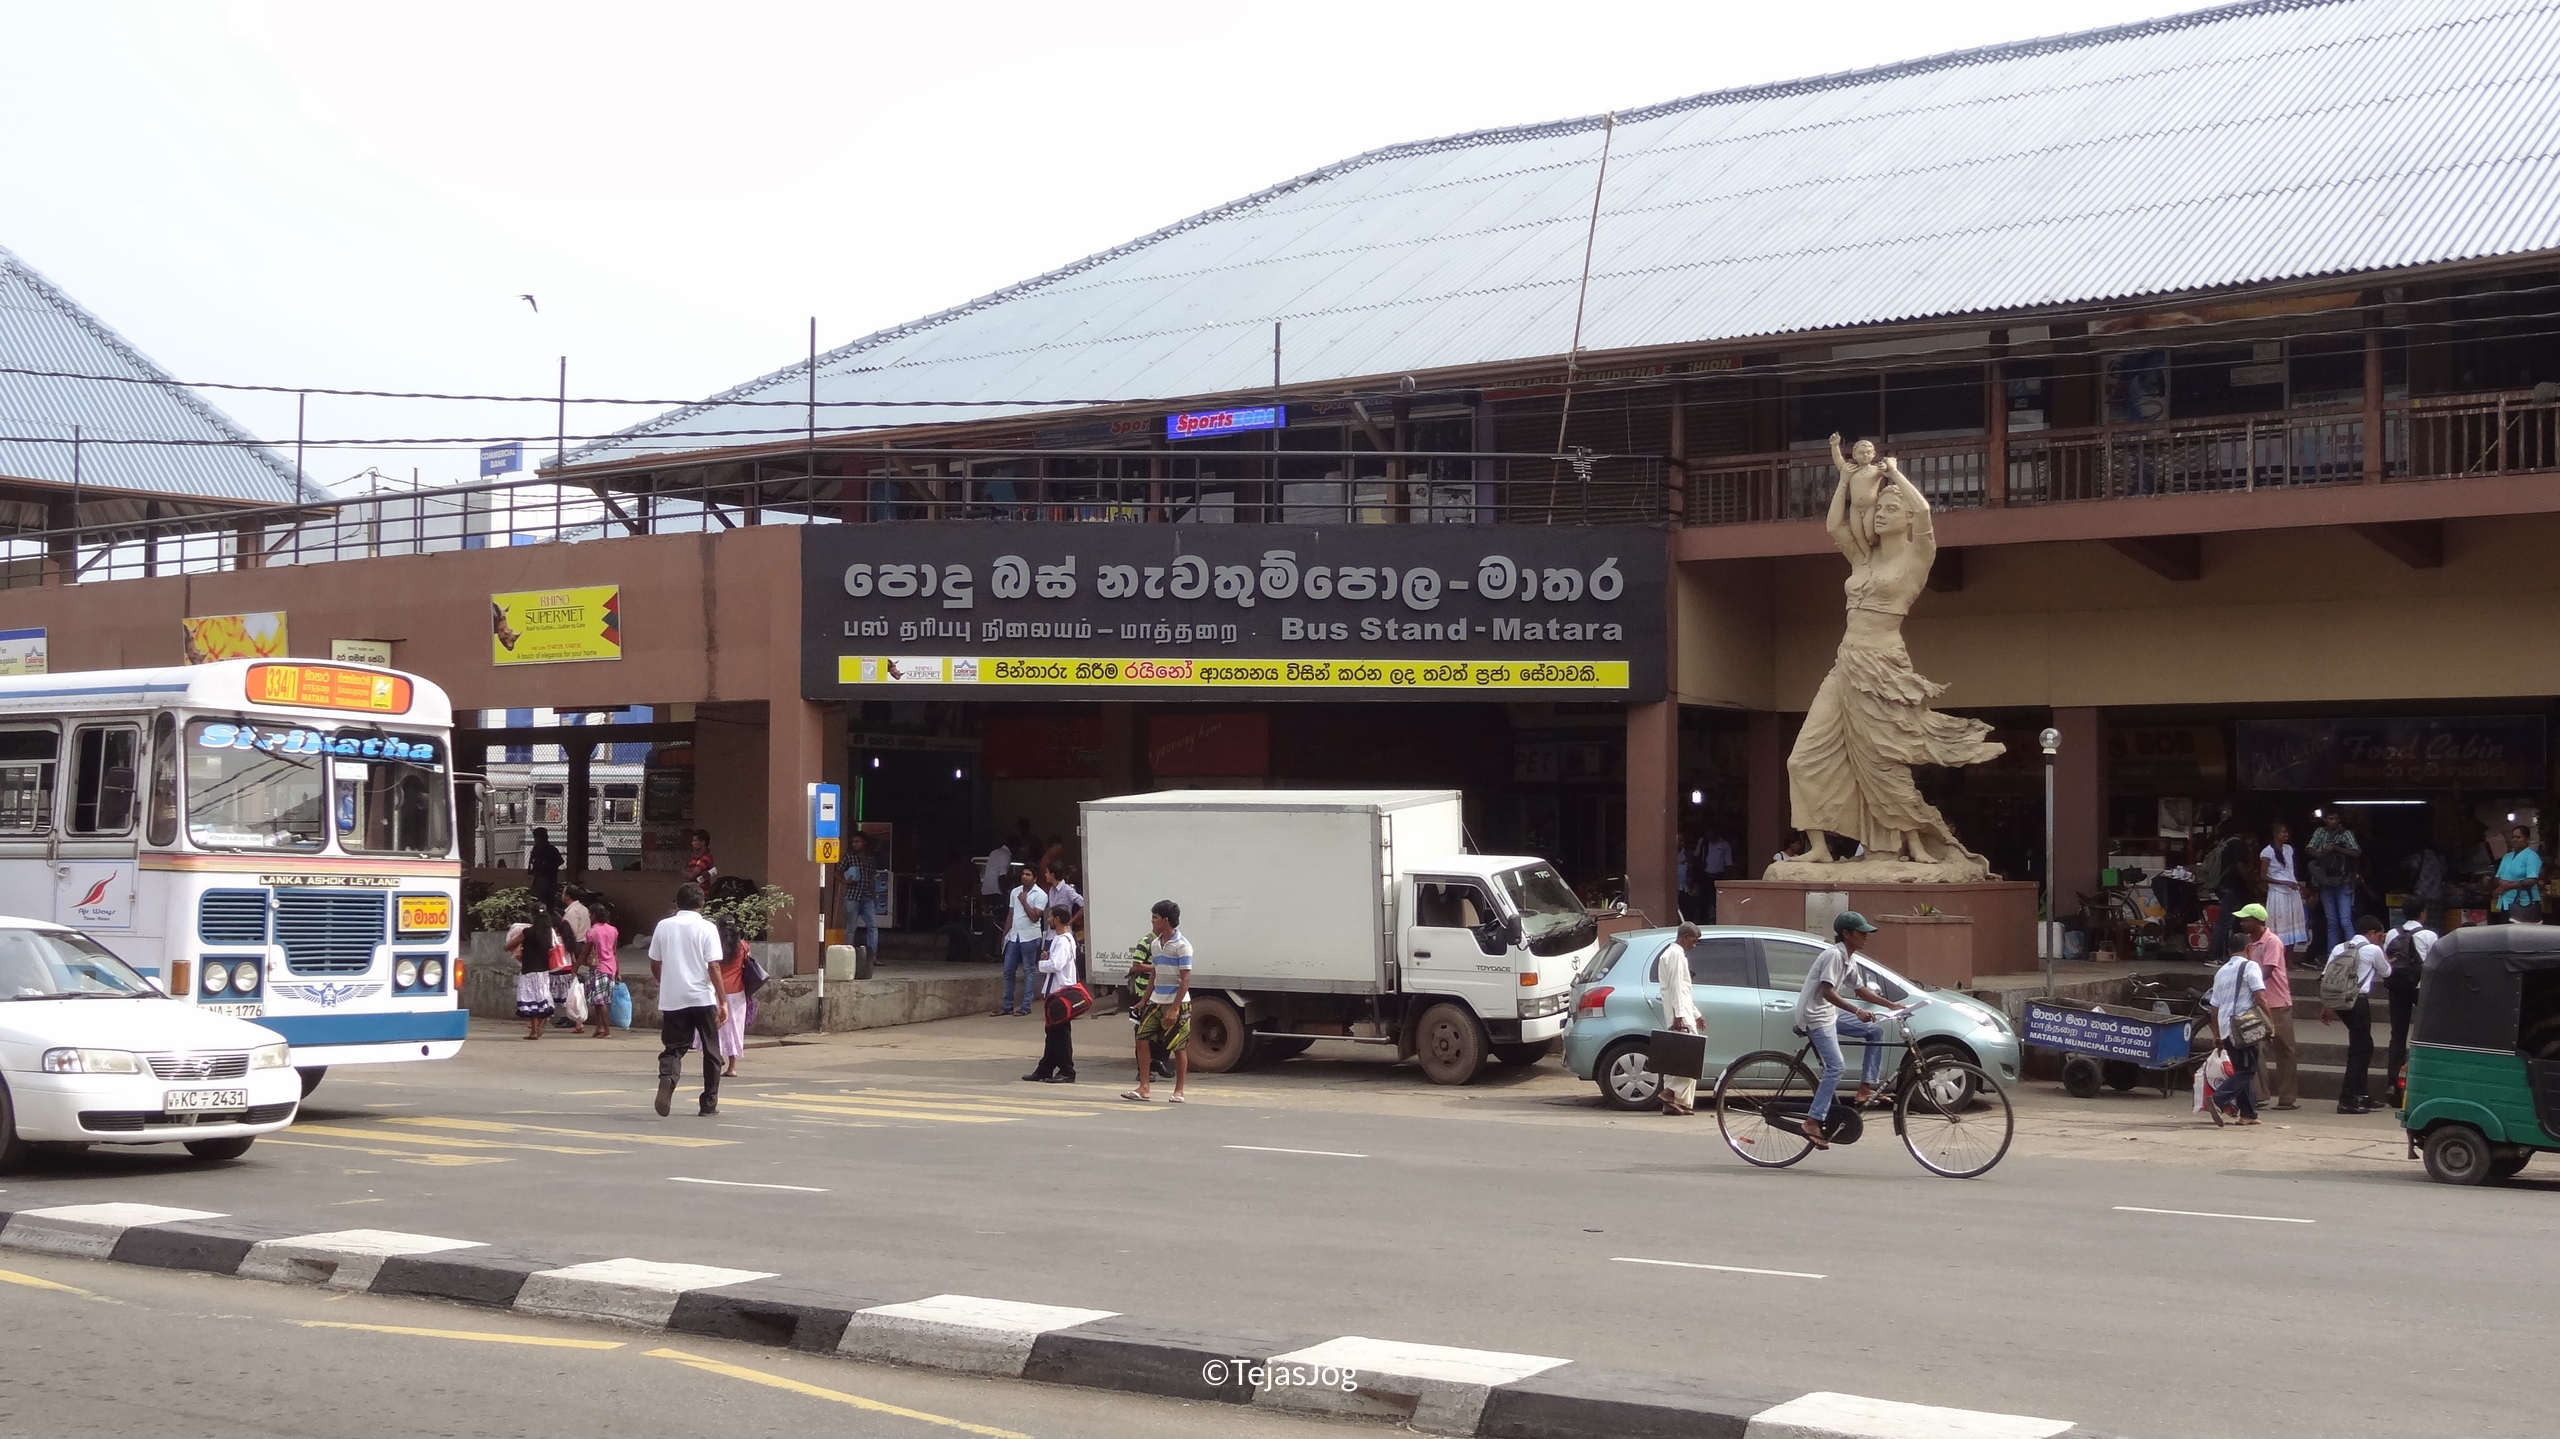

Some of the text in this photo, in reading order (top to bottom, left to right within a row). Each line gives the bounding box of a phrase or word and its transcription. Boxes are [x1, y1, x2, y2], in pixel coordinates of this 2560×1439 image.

[1662, 358, 1733, 374] FHION
[480, 448, 516, 461] COMMERCIAL
[490, 458, 507, 469] BANK
[844, 563, 973, 609] පොදු
[991, 554, 1077, 600] බස්
[540, 594, 571, 607] RHINO
[525, 608, 585, 625] SUPERMET
[844, 615, 889, 637] பஸ்
[1281, 617, 1349, 641] Bus
[541, 650, 563, 660] elegance
[571, 650, 583, 659] your
[583, 648, 597, 656] home
[1124, 660, 1193, 680] රයිනෝ
[1199, 666, 1279, 684] ආයතනය
[1286, 663, 1331, 681] විසින්
[1338, 665, 1382, 681] කරන
[1390, 669, 1417, 685] ලද
[1423, 663, 1468, 682] තවත්
[267, 668, 298, 699] 334/1
[301, 693, 330, 704] MATARA
[2341, 733, 2420, 760] Food
[2425, 733, 2504, 760] Cabin
[260, 875, 400, 887] LANKA ASHOK LEYLAND
[78, 908, 116, 916] Air Ways
[413, 908, 447, 925] මාතර
[2032, 1007, 2152, 1037] මාතර මහා නගර සභාව
[2029, 1031, 2150, 1059] MATARA MUNICIPAL COUNCIL
